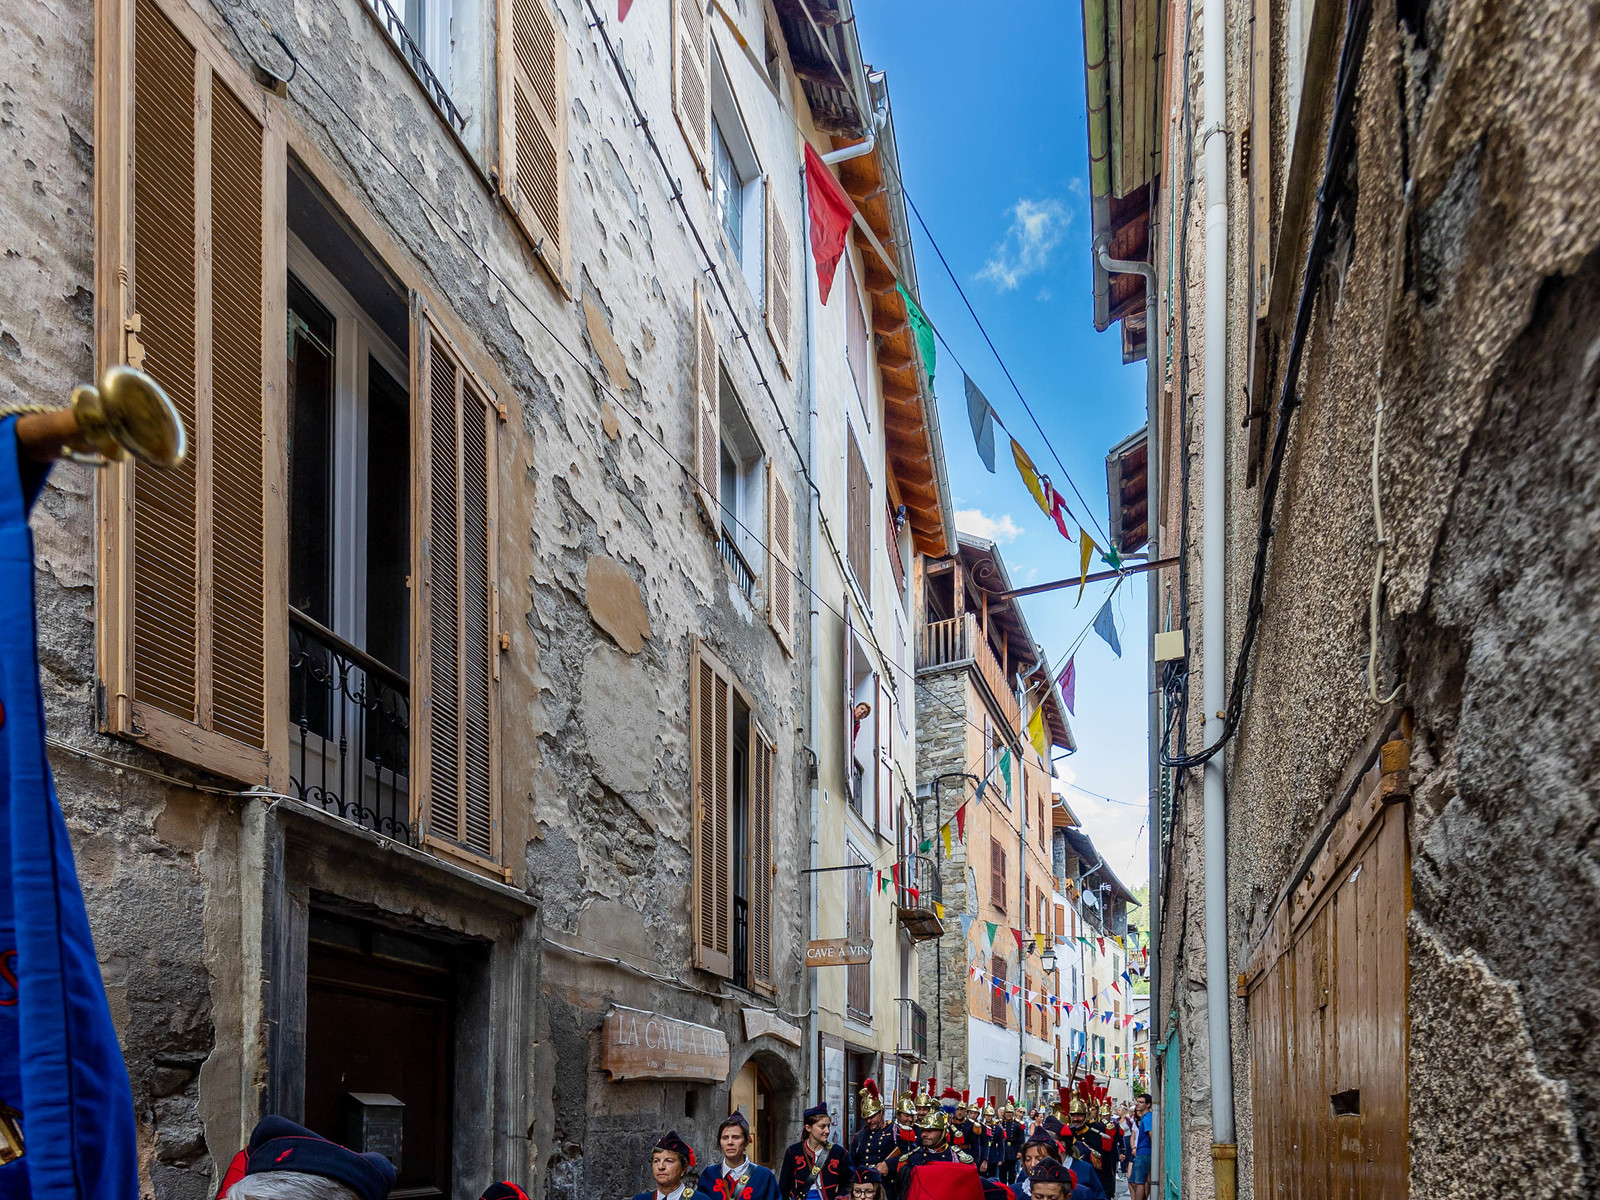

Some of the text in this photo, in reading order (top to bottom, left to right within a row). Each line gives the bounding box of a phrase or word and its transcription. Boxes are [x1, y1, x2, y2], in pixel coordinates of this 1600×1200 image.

[806, 944, 870, 959] CAVE A VIN
[618, 1014, 725, 1058] LA CAVE A VIN
